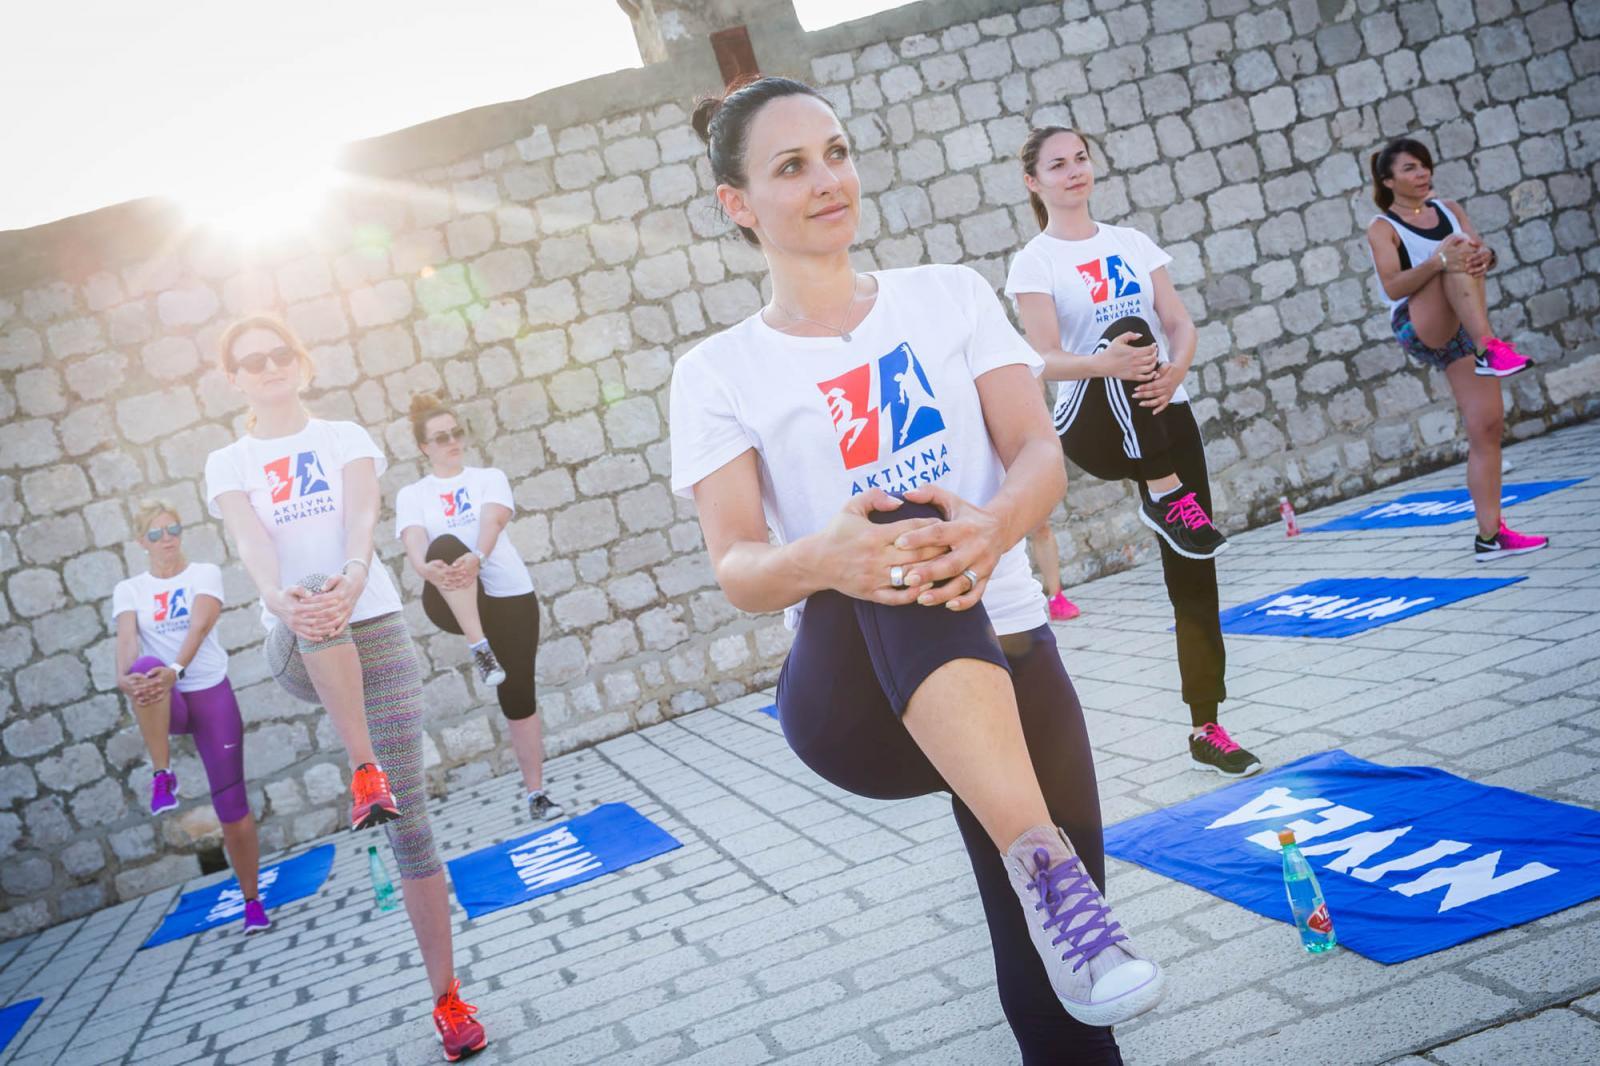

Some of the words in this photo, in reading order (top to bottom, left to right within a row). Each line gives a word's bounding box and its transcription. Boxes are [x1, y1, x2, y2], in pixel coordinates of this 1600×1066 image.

[1095, 298, 1141, 316] AKTIVNA
[1096, 307, 1141, 323] HRVATSKA
[851, 443, 948, 496] AKTIVNA
[884, 461, 951, 494] ATSKA
[273, 496, 333, 517] AKTIVNA
[275, 505, 336, 525] HRVATSKA
[1205, 786, 1560, 913] NIVEA
